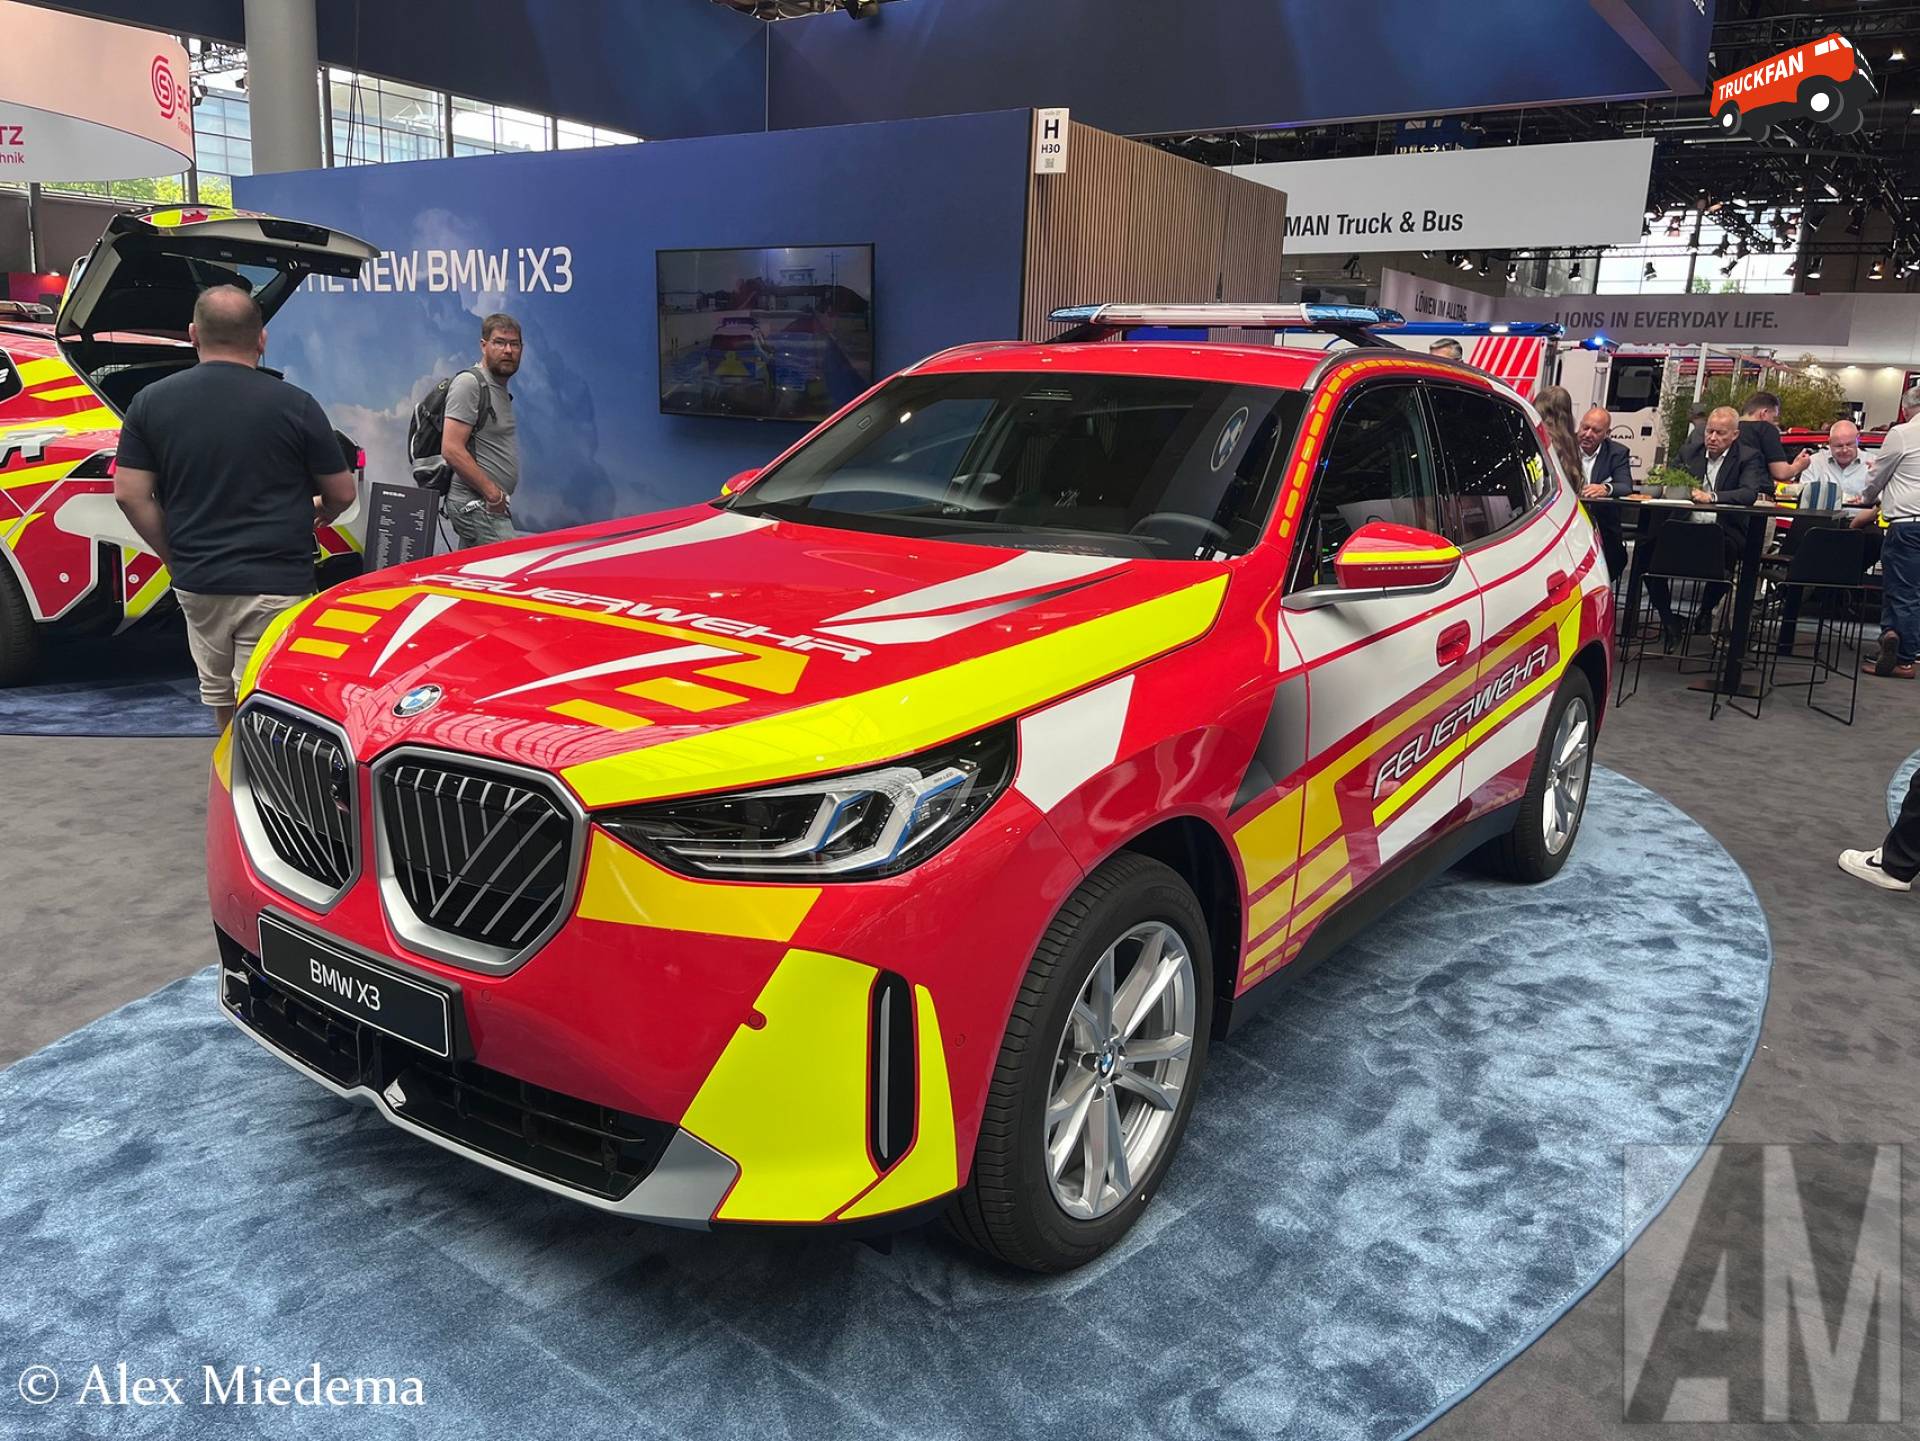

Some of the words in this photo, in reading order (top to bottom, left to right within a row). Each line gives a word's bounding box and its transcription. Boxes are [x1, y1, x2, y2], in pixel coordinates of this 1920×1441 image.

[1044, 119, 1060, 139] H
[1041, 143, 1061, 154] H30
[1285, 214, 1330, 237] MAN
[1336, 212, 1393, 235] Truck
[1400, 211, 1415, 233] &
[1422, 210, 1464, 232] Bus
[352, 250, 418, 292] NEW
[427, 248, 509, 293] BMW
[518, 246, 573, 293] iX3
[1610, 311, 1629, 328] IN
[1633, 311, 1729, 328] EVERYDAY
[1733, 311, 1779, 328] LIFE.
[409, 573, 874, 663] FEUERWEHR
[1372, 643, 1550, 800] FEUERWEHR
[309, 957, 353, 1000] BMW
[356, 979, 381, 1011] X3
